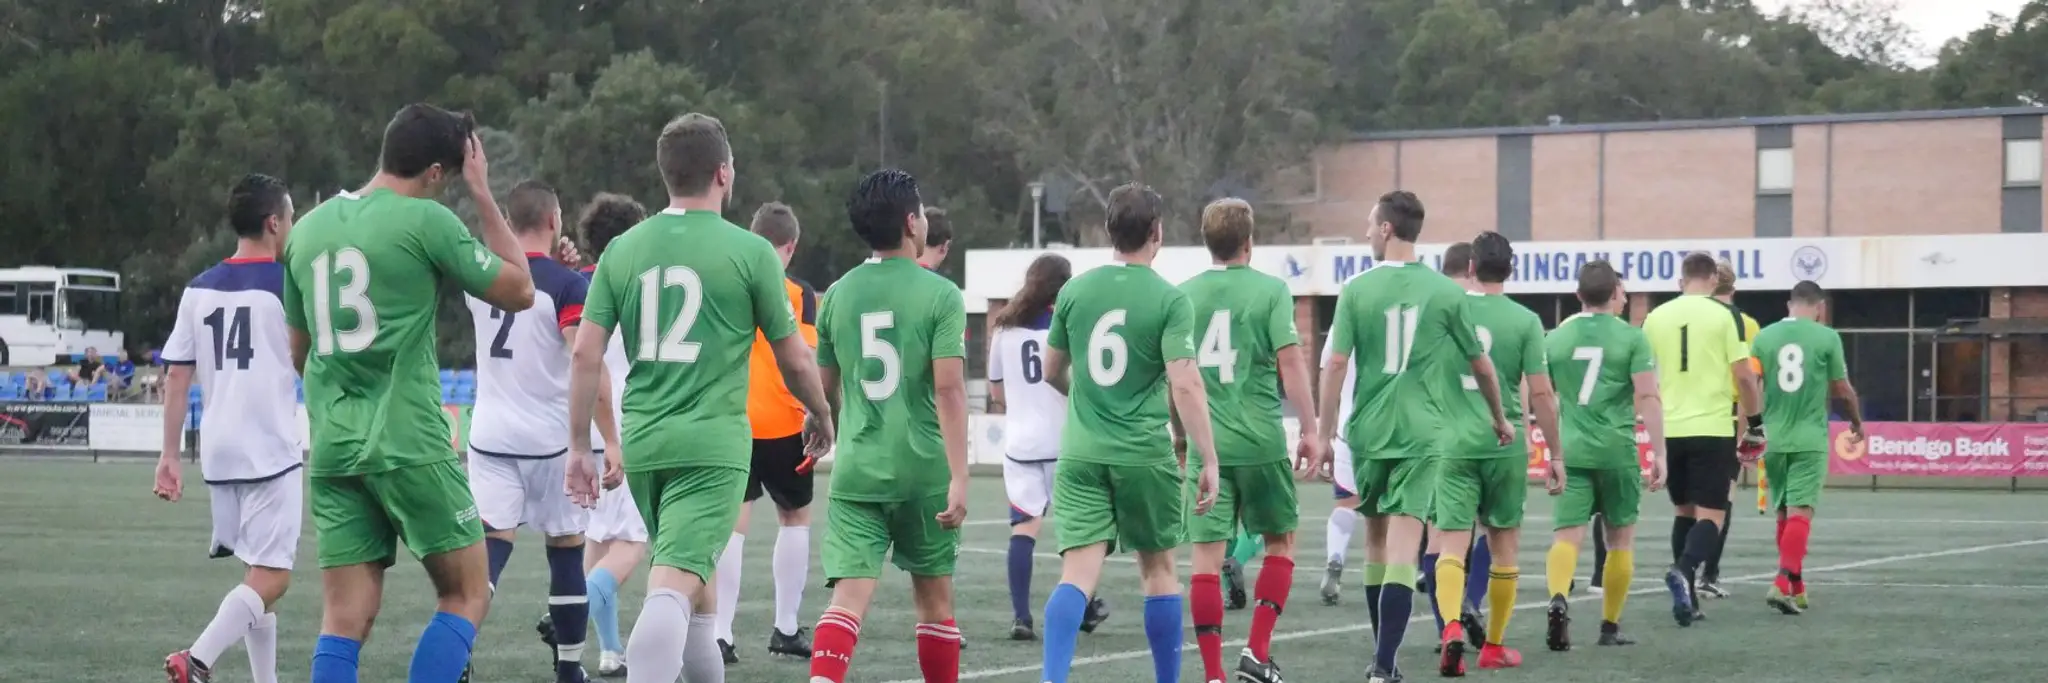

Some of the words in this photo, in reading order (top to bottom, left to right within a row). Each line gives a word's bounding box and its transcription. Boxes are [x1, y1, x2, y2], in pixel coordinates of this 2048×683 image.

[311, 247, 379, 356] 13
[638, 265, 703, 363] 12
[203, 306, 254, 371] 14
[860, 310, 901, 400] 5
[1021, 339, 1043, 384] 6
[1088, 308, 1128, 387] 6
[1198, 309, 1238, 384] 4
[1381, 305, 1419, 374] 11
[1679, 323, 1689, 372] 1
[1777, 343, 1805, 393] 8
[1572, 346, 1604, 406] 7
[1868, 436, 1952, 460] Bendigo
[1955, 437, 2010, 457] Bank
